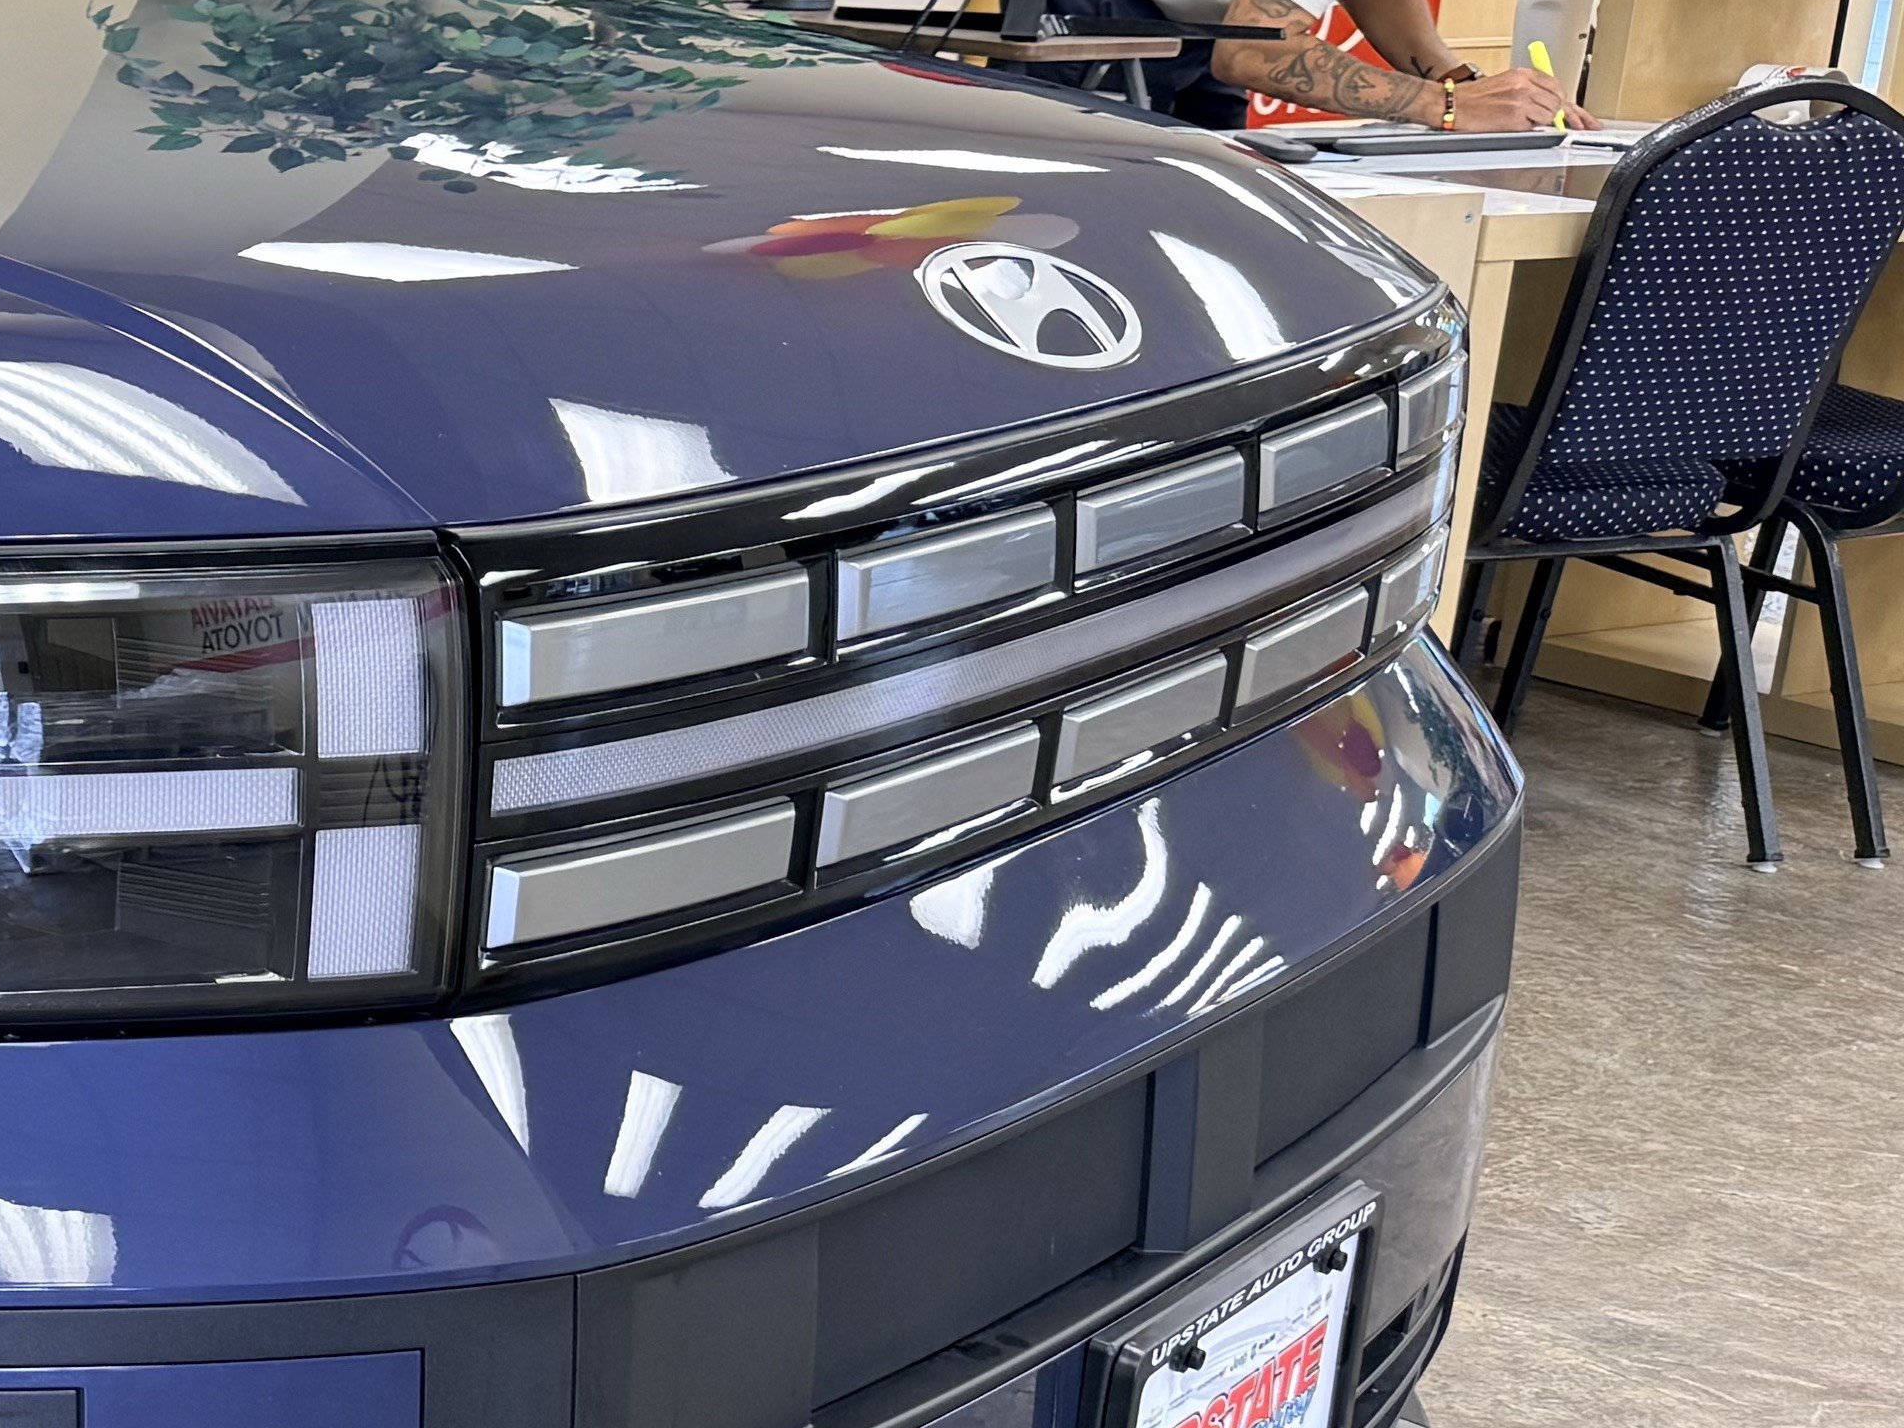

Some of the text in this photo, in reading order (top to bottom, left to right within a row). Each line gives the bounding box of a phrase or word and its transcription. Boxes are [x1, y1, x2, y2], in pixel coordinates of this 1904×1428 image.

[1151, 1288, 1247, 1368] UPSTATE
[1246, 1250, 1303, 1302] AUTO
[1306, 1201, 1377, 1259] GROUP
